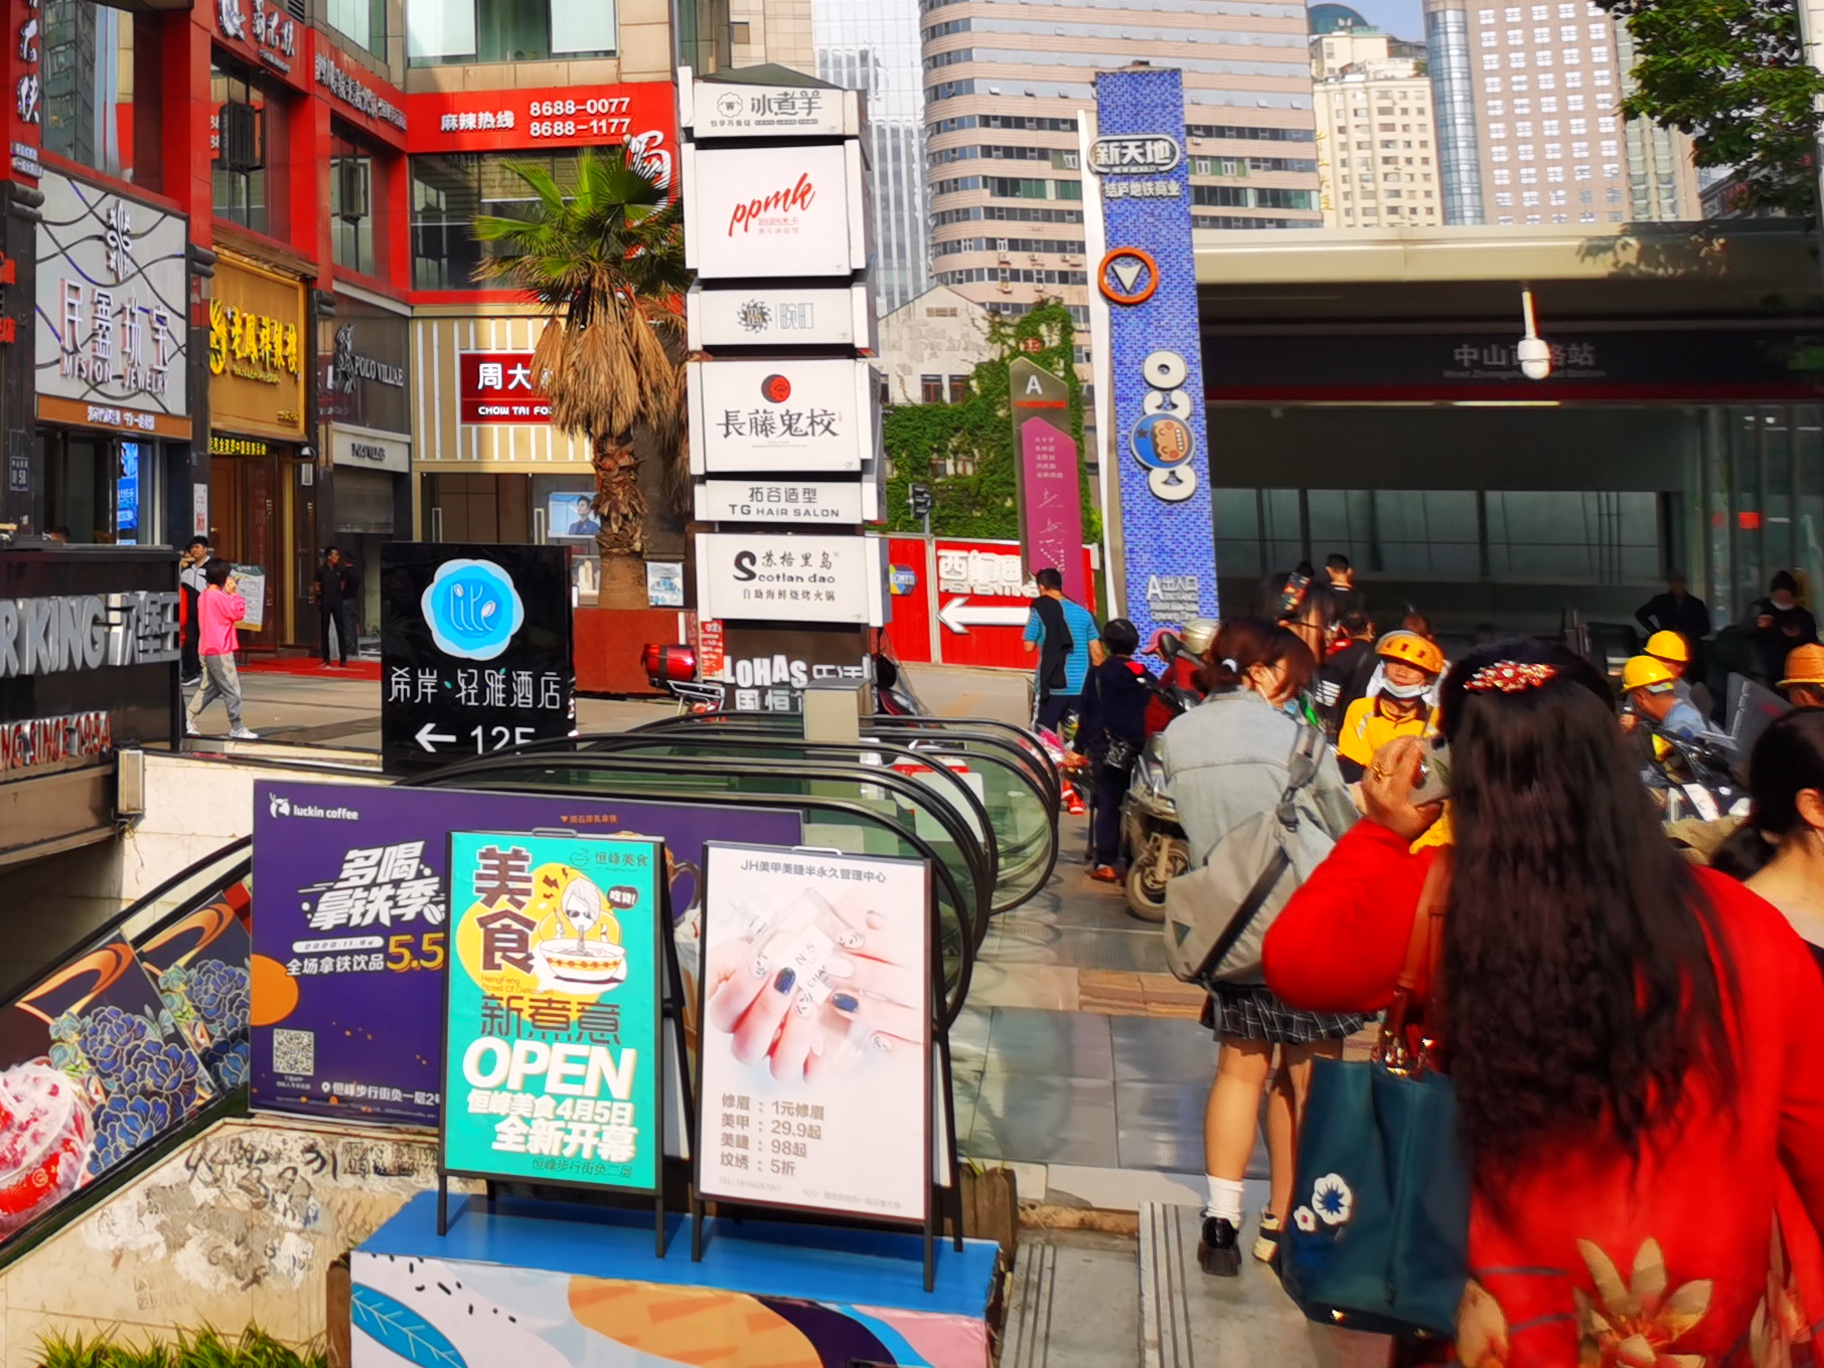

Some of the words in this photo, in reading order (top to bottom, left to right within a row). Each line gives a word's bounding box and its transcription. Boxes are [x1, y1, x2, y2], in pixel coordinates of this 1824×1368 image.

[529, 97, 631, 118] 8688-0077
[750, 90, 824, 117] 冰煮羊
[440, 110, 516, 131] 麻辣热线
[529, 118, 631, 138] 8688-1177
[1095, 140, 1172, 165] 新天地
[728, 172, 816, 237] ppmk
[355, 355, 377, 380] POLO
[123, 368, 170, 395] JEWELRY
[1025, 375, 1043, 395] A
[478, 404, 509, 416] CHOW
[512, 404, 530, 416] TAI
[716, 408, 841, 439] 長藤鬼校
[749, 486, 818, 504] 拓谷造型
[728, 504, 752, 516] TG
[756, 507, 789, 517] HAIR
[793, 508, 840, 518] SALON
[761, 550, 833, 570] 苏格里岛
[743, 588, 836, 602] 自助海鲜烧烤火锅
[1146, 574, 1164, 600] A
[23, 594, 106, 676] KING
[723, 654, 809, 689] LOHAS
[29, 714, 70, 766] SINCE
[77, 710, 111, 755] 1954
[293, 804, 324, 818] luckin
[326, 807, 359, 821] coffee
[334, 840, 426, 889] 多喝
[595, 850, 649, 868] 恒峰美食
[740, 859, 887, 884] JH美甲美睫半永久管理中心
[308, 876, 441, 931] 拿铁季
[473, 845, 538, 975] 美食
[286, 952, 385, 977] 全场拿铁饮品
[385, 932, 445, 974] 5.5
[462, 1035, 637, 1101] OPEN
[467, 1088, 634, 1128] 恒峰美食4月5日
[770, 1099, 824, 1121] 1元修眉
[491, 1114, 638, 1165] 全新开幕
[770, 1119, 822, 1140] 29.9起
[770, 1138, 808, 1159] 98起
[769, 1158, 796, 1177] 5折
